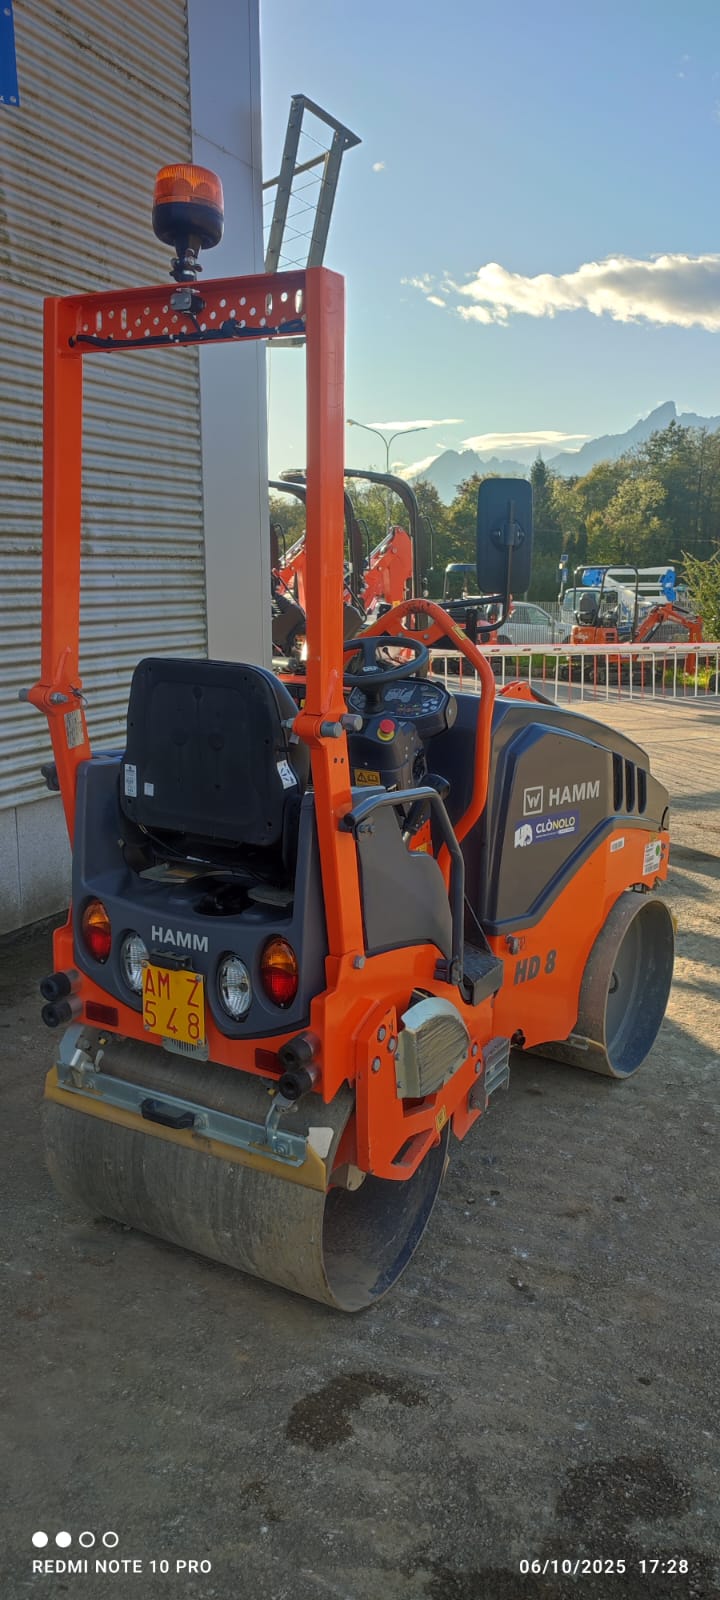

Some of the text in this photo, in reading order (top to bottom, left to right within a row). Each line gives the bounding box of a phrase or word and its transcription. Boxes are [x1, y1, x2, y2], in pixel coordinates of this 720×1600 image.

[549, 780, 600, 807] HAMM
[535, 816, 576, 834] CLÒNOLO
[151, 925, 209, 953] HAMM
[513, 949, 557, 986] HD 8
[144, 968, 199, 1008] AM Z
